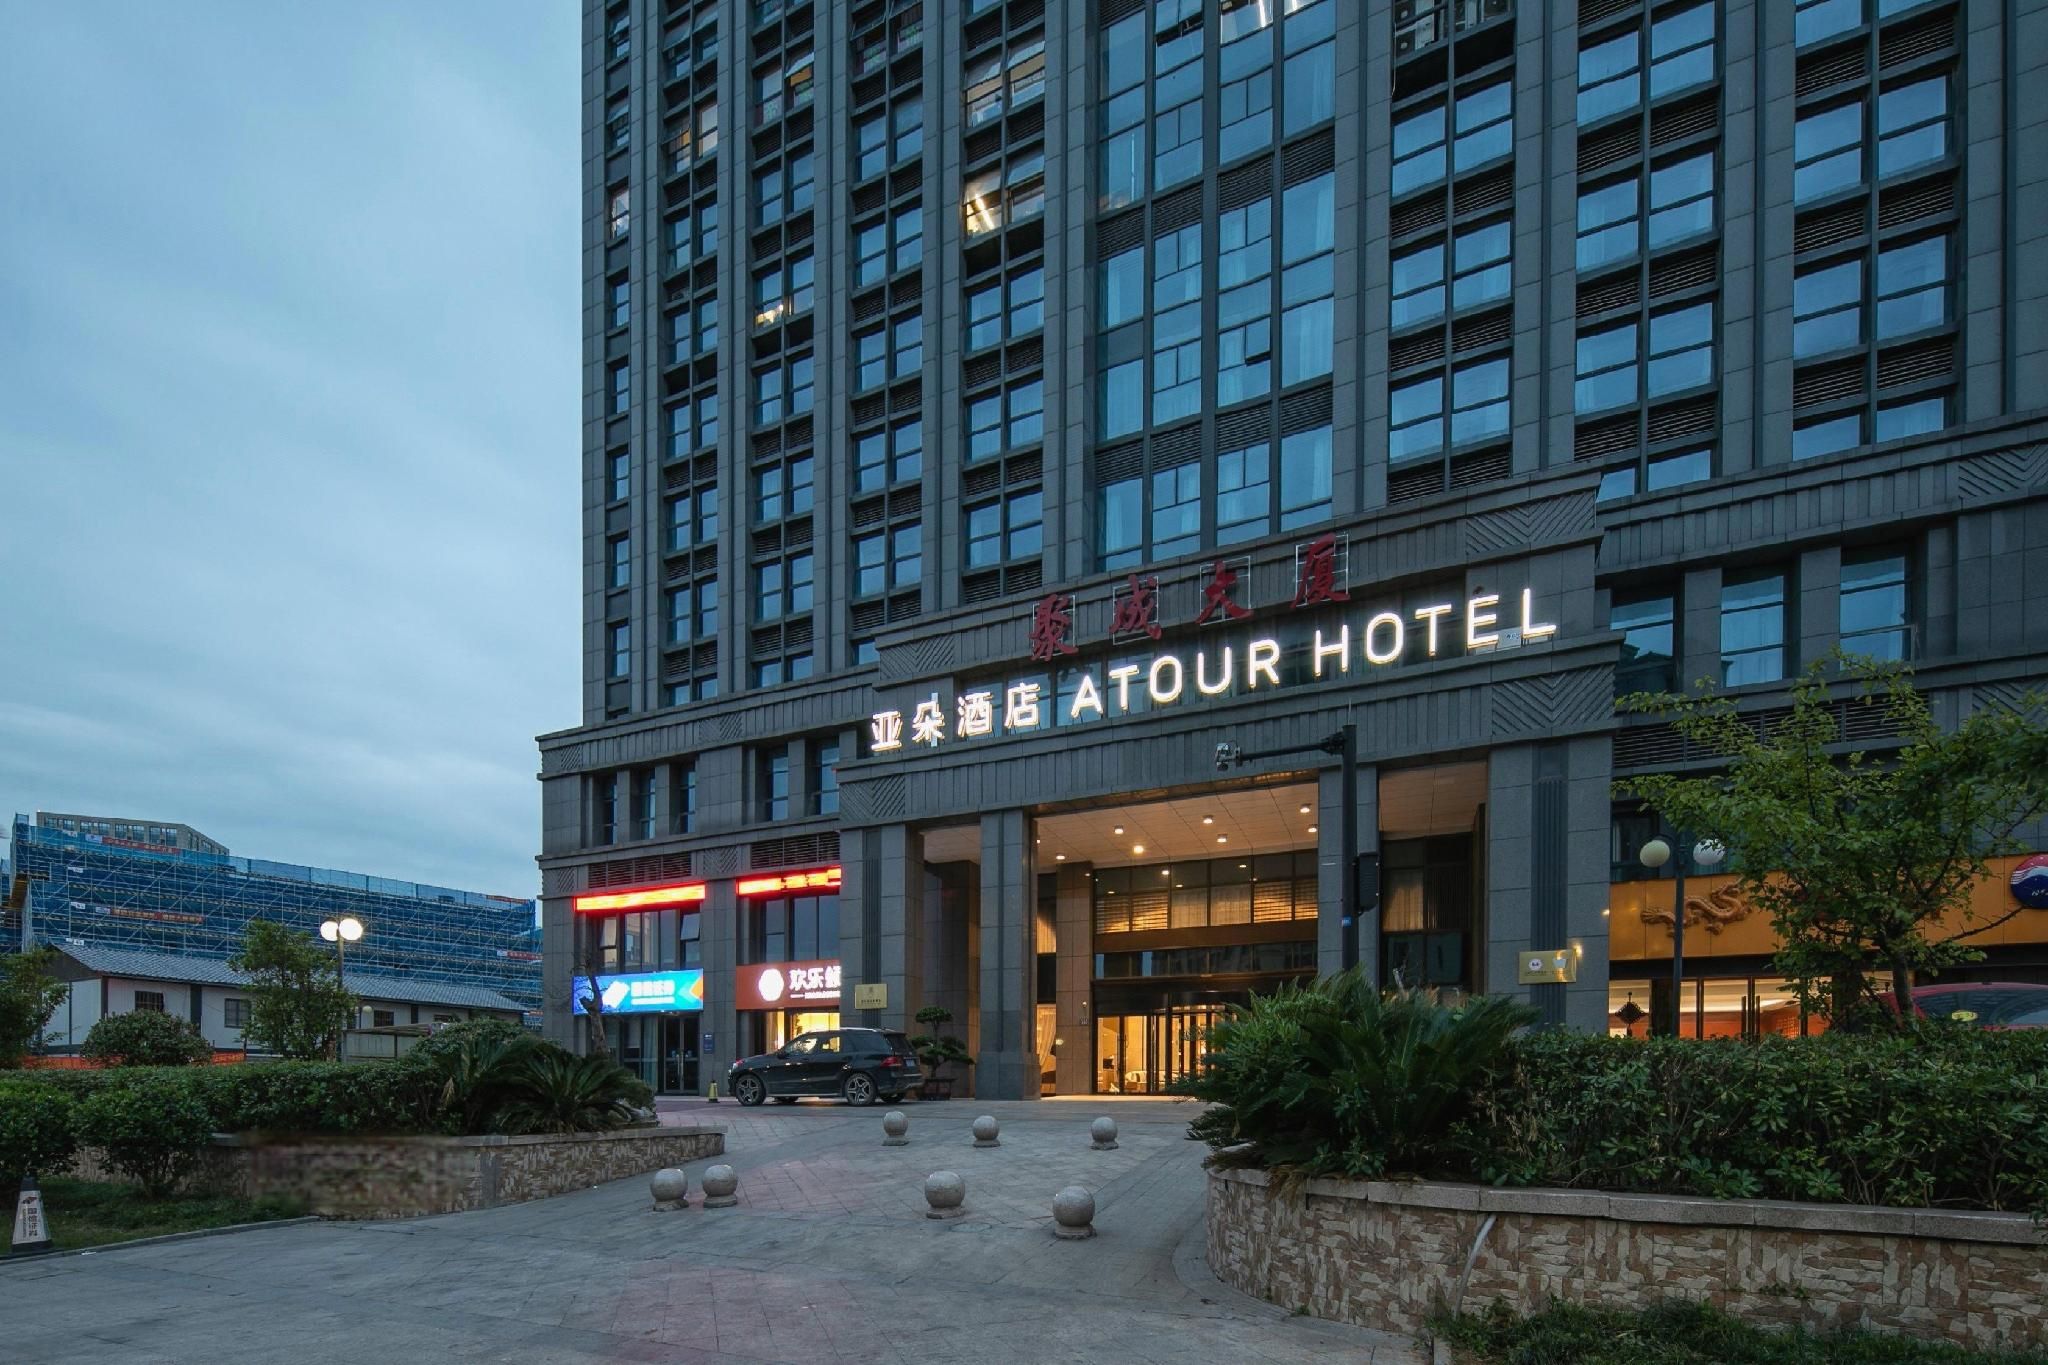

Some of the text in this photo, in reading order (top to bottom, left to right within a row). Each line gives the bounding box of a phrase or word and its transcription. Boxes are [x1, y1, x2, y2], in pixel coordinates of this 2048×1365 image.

[871, 588, 1557, 751] 亚朵酒店 ATOUR HOTEL
